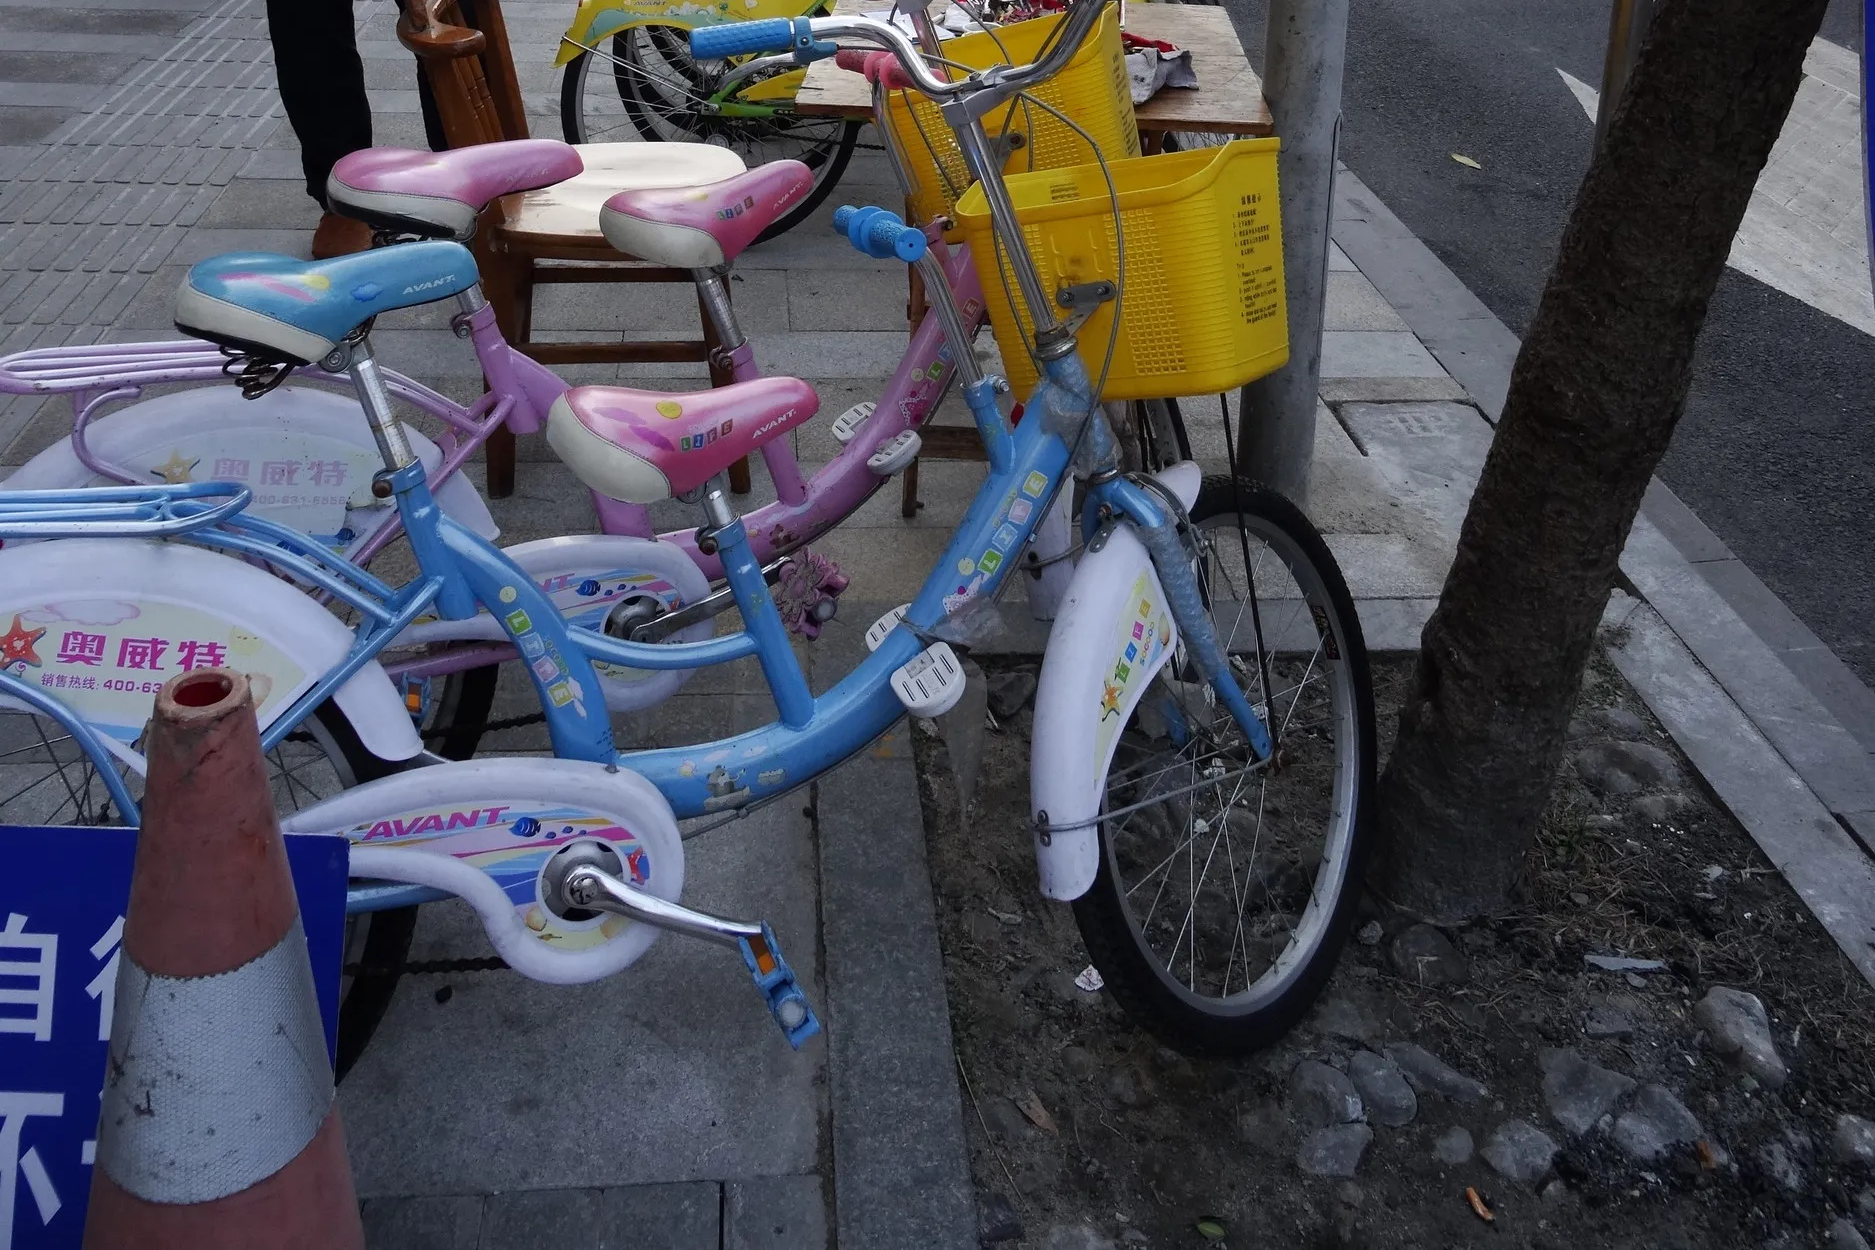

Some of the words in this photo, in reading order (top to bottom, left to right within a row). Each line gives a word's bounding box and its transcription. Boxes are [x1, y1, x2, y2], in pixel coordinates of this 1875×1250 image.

[403, 274, 455, 295] AVANT
[682, 420, 732, 450] LIFE
[752, 408, 796, 439] AVANT
[210, 458, 348, 487] 奥威特
[56, 630, 230, 672] 奥威特
[361, 806, 510, 841] AVANT
